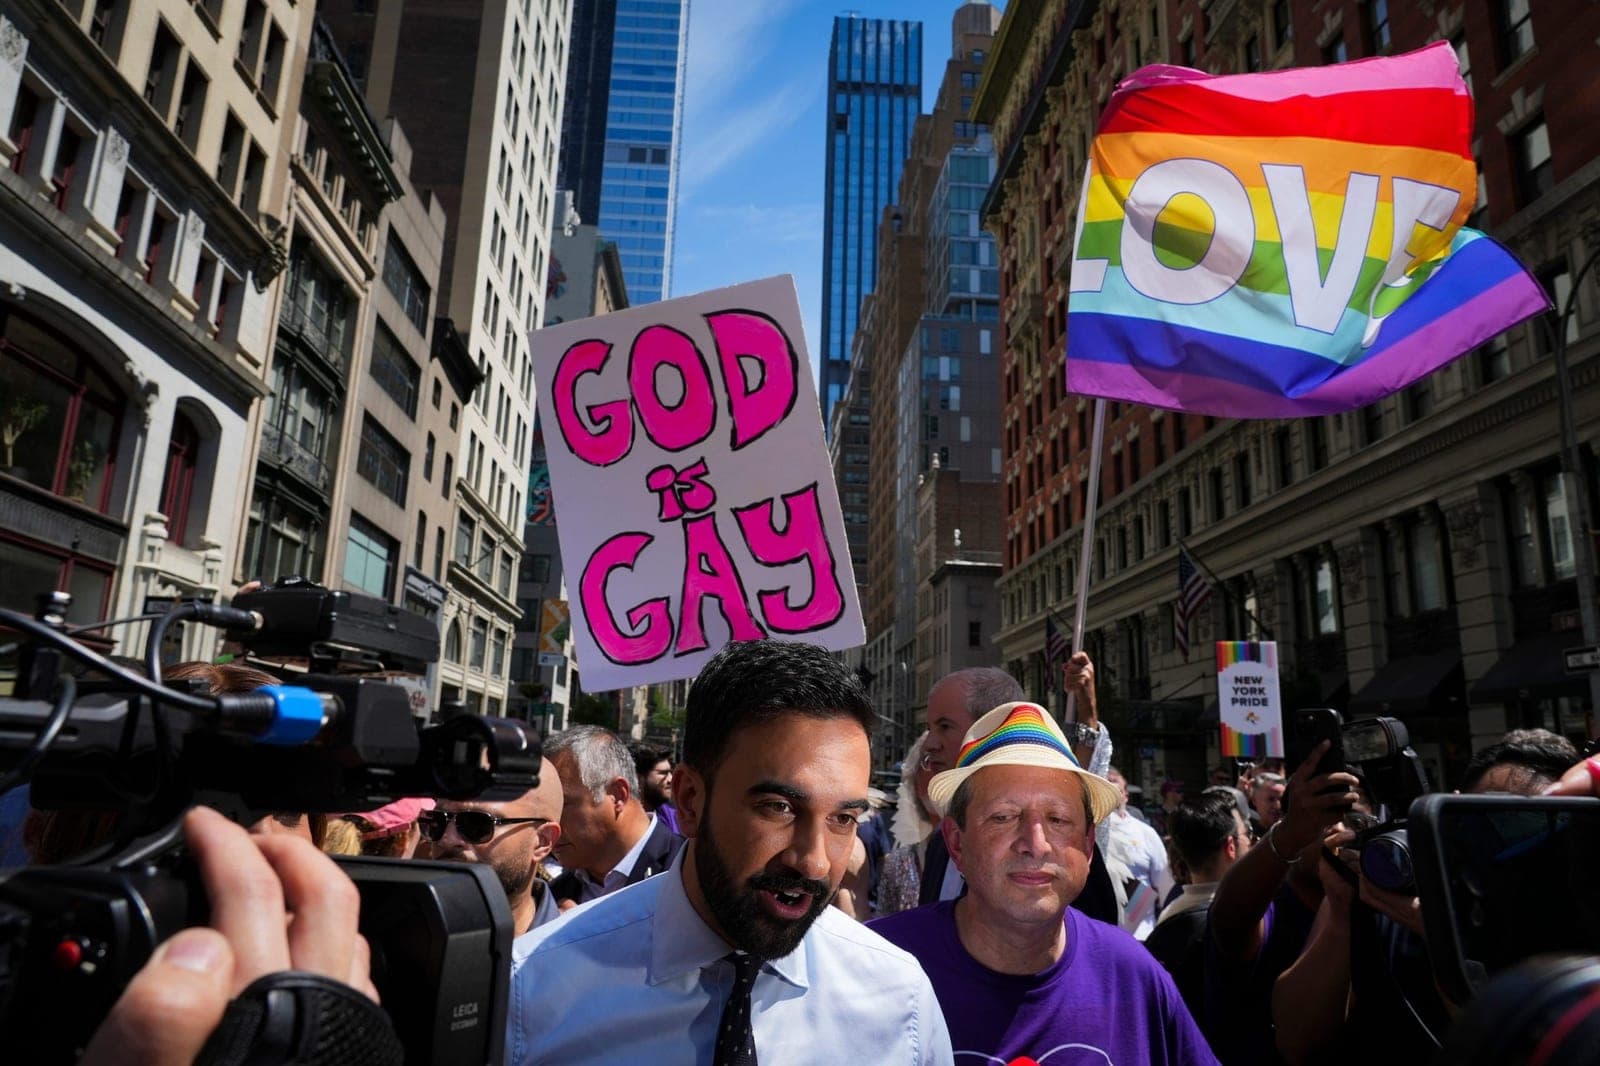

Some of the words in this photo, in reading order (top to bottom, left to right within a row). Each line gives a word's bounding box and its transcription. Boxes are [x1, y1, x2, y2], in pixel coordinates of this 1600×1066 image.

[551, 308, 799, 468] GOD
[645, 456, 718, 522] is
[578, 481, 846, 666] GAY
[1234, 675, 1263, 685] NEW
[1232, 686, 1266, 696] YORK
[1231, 697, 1269, 707] PRIDE
[452, 1002, 479, 1018] LEICA
